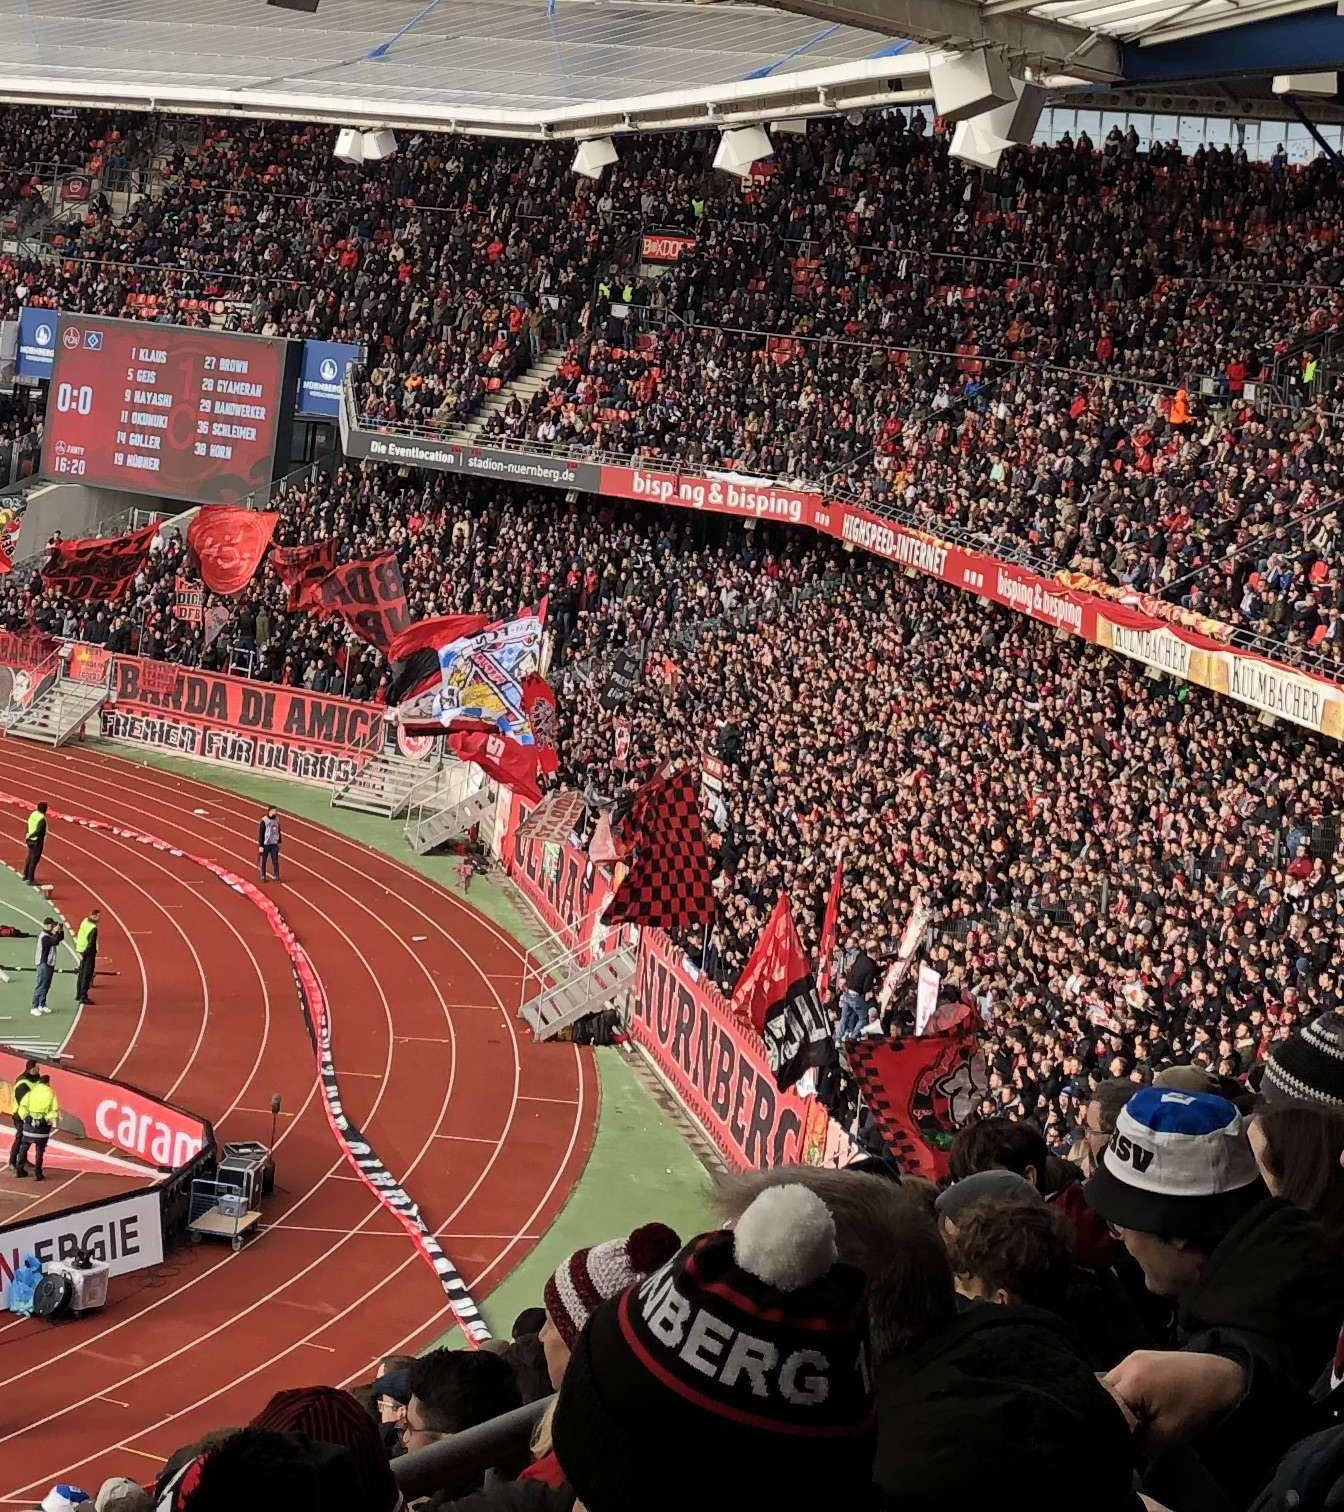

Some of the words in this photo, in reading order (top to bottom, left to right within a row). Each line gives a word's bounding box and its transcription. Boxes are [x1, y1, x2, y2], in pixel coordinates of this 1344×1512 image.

[138, 347, 168, 364] KLAUS
[204, 356, 216, 370] 27
[219, 357, 249, 374] BROWN
[126, 368, 134, 381] 5
[136, 368, 157, 384] GEIS
[57, 383, 93, 415] 0:0
[124, 389, 131, 402] 9
[133, 390, 173, 408] HAYASHI
[120, 410, 129, 423] 11
[116, 430, 127, 445] 14
[128, 432, 161, 450] GOLLER
[113, 452, 124, 466] 19
[209, 443, 233, 460] HORN
[370, 440, 386, 455] Die
[388, 443, 454, 465] Eventlocation
[467, 457, 576, 483] stadion-nuernberg.de
[54, 456, 86, 476] 16:20
[632, 471, 705, 509] bispng
[707, 482, 724, 505] &
[727, 484, 803, 523] bisping
[841, 512, 948, 577] HIGHSPEED-INTERNET
[1231, 655, 1321, 726] KULMBACHER
[239, 690, 277, 730] DI
